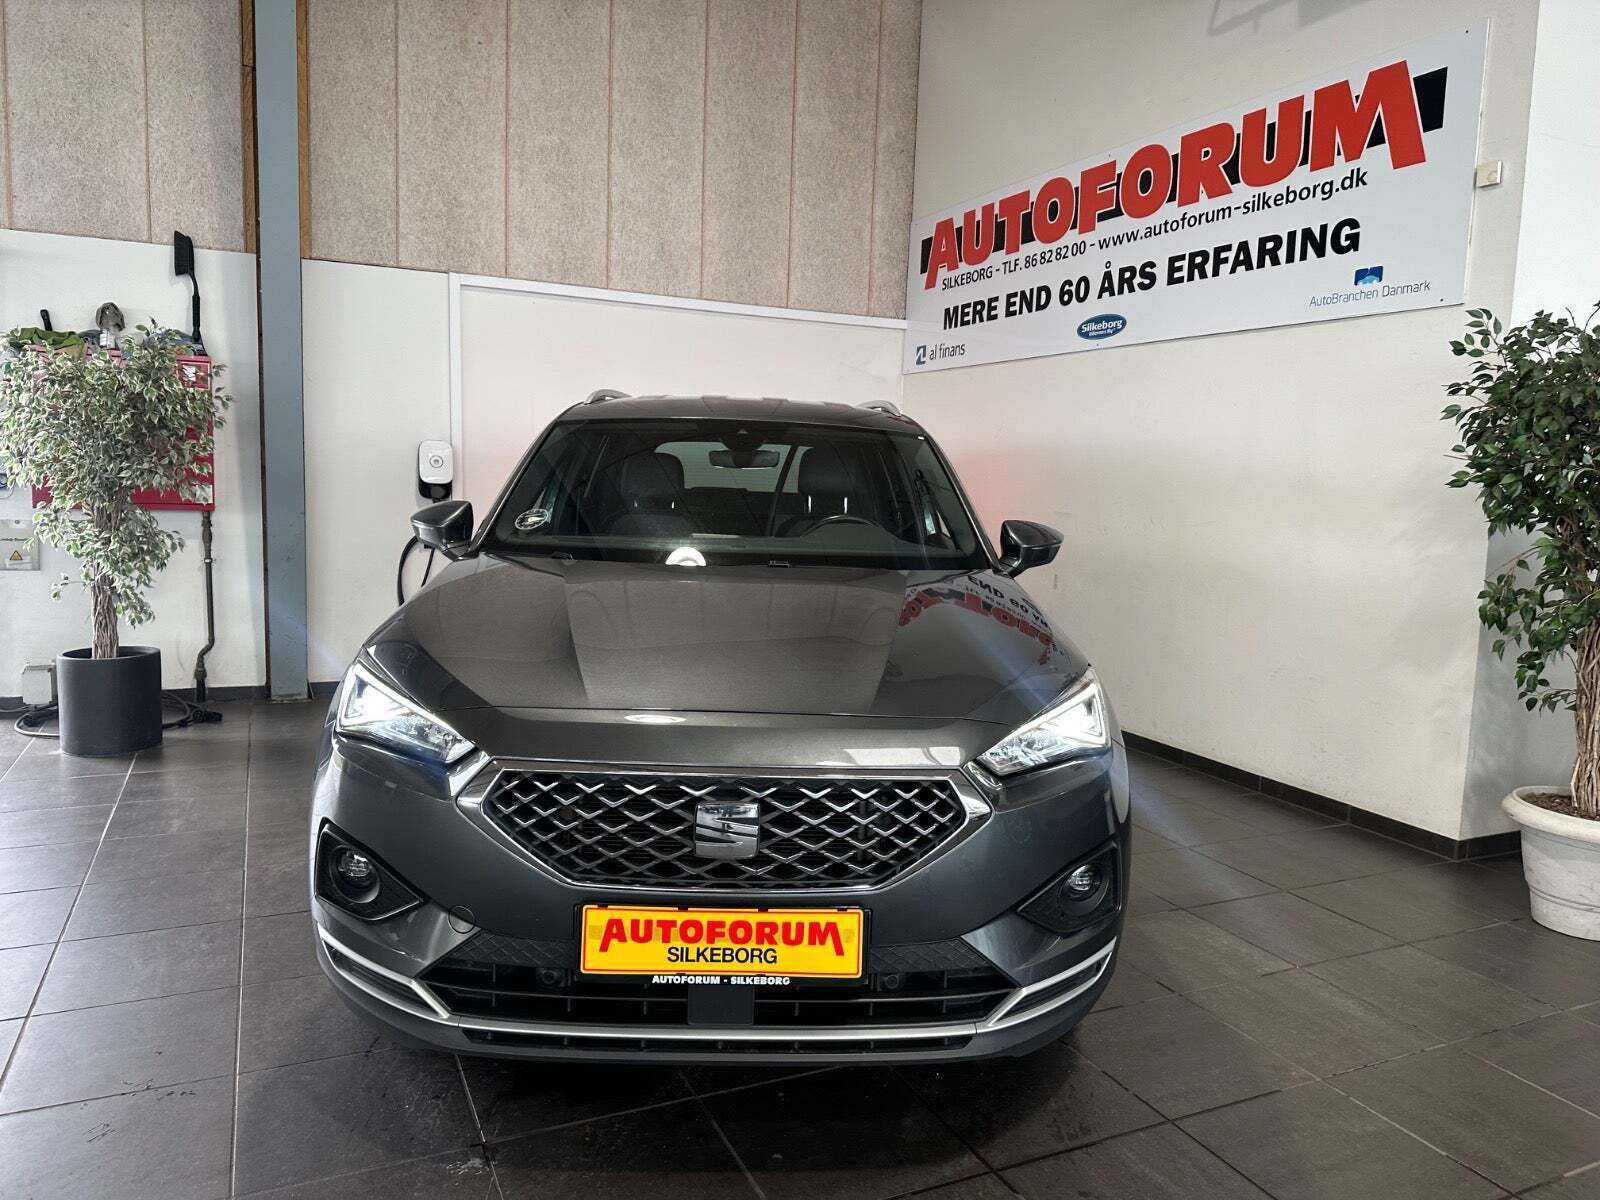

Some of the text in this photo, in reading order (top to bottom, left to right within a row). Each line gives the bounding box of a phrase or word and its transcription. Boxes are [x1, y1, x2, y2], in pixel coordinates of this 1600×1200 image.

[925, 60, 1426, 289] AUTOFORUM
[942, 265, 993, 291] SILKEBORG
[1002, 258, 1023, 275] TLF.
[1098, 167, 1368, 250] www.autoforum-silkeborg.dk
[943, 217, 1361, 331] MERE END 60 ÅRS ERFARING
[1309, 280, 1431, 307] AutoBranchen Danmark
[1081, 319, 1123, 332] Silkeborg
[929, 342, 966, 361] al finans
[599, 918, 845, 956] AUTOFORUM
[667, 946, 778, 964] SILKEBORG
[652, 975, 720, 984] AUTOFORUM
[730, 976, 791, 985] SILKEBORG
